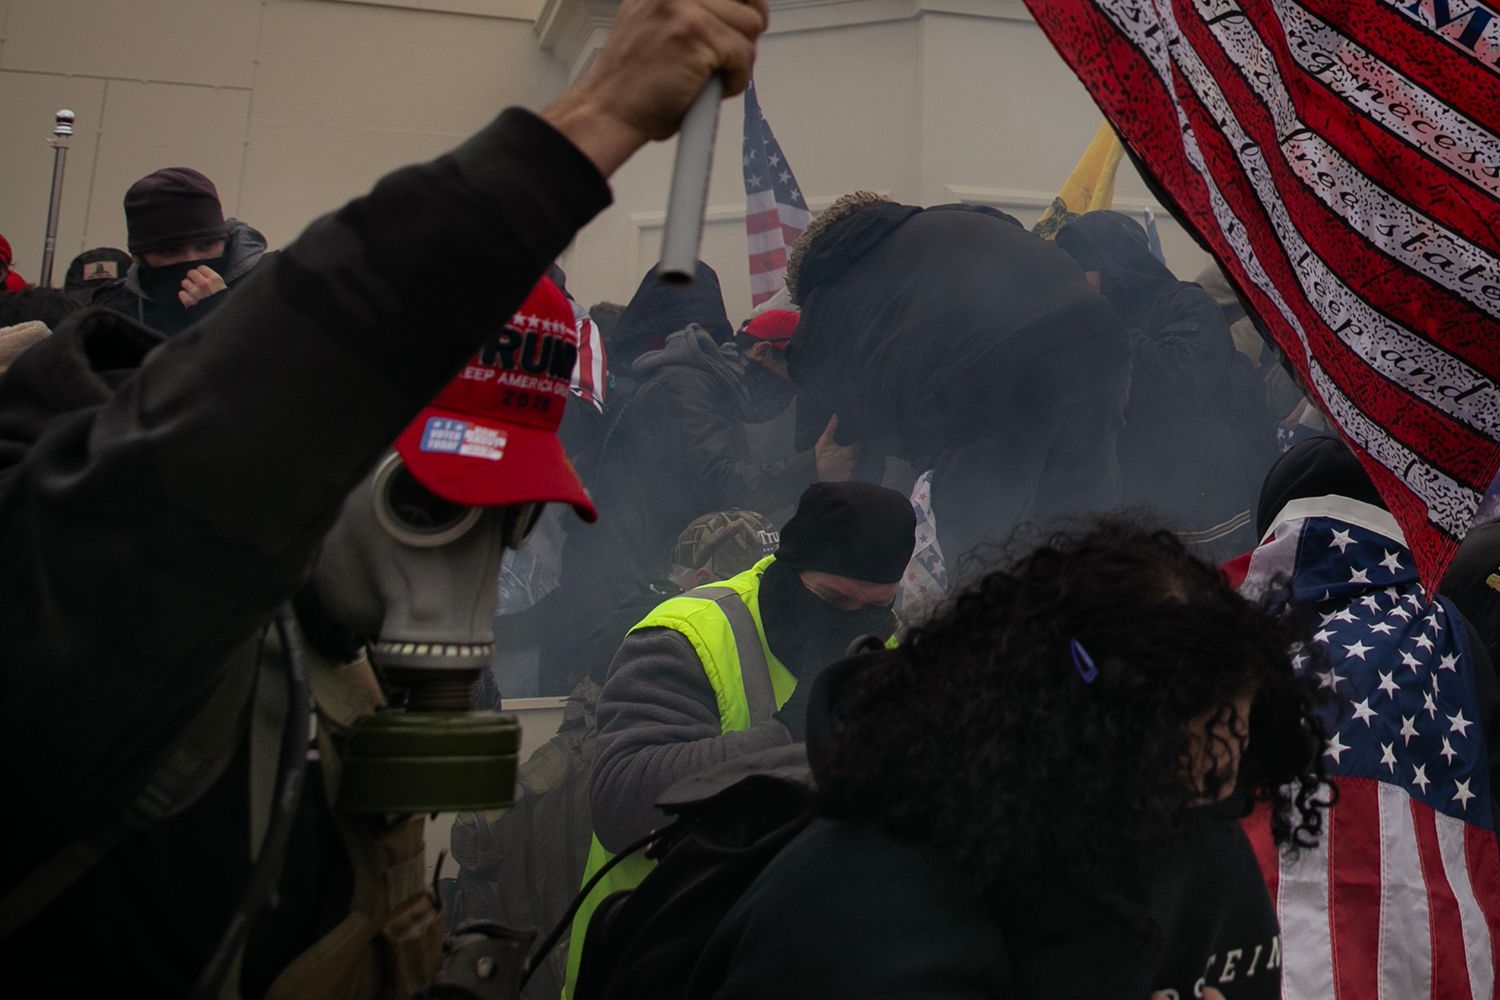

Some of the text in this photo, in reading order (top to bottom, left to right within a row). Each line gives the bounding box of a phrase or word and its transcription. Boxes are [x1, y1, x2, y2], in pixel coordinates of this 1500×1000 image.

[1281, 126, 1358, 208] free
[1299, 251, 1363, 340] keep
[1382, 348, 1490, 404] and
[460, 366, 496, 382] EEP
[498, 372, 554, 393] AMERICA
